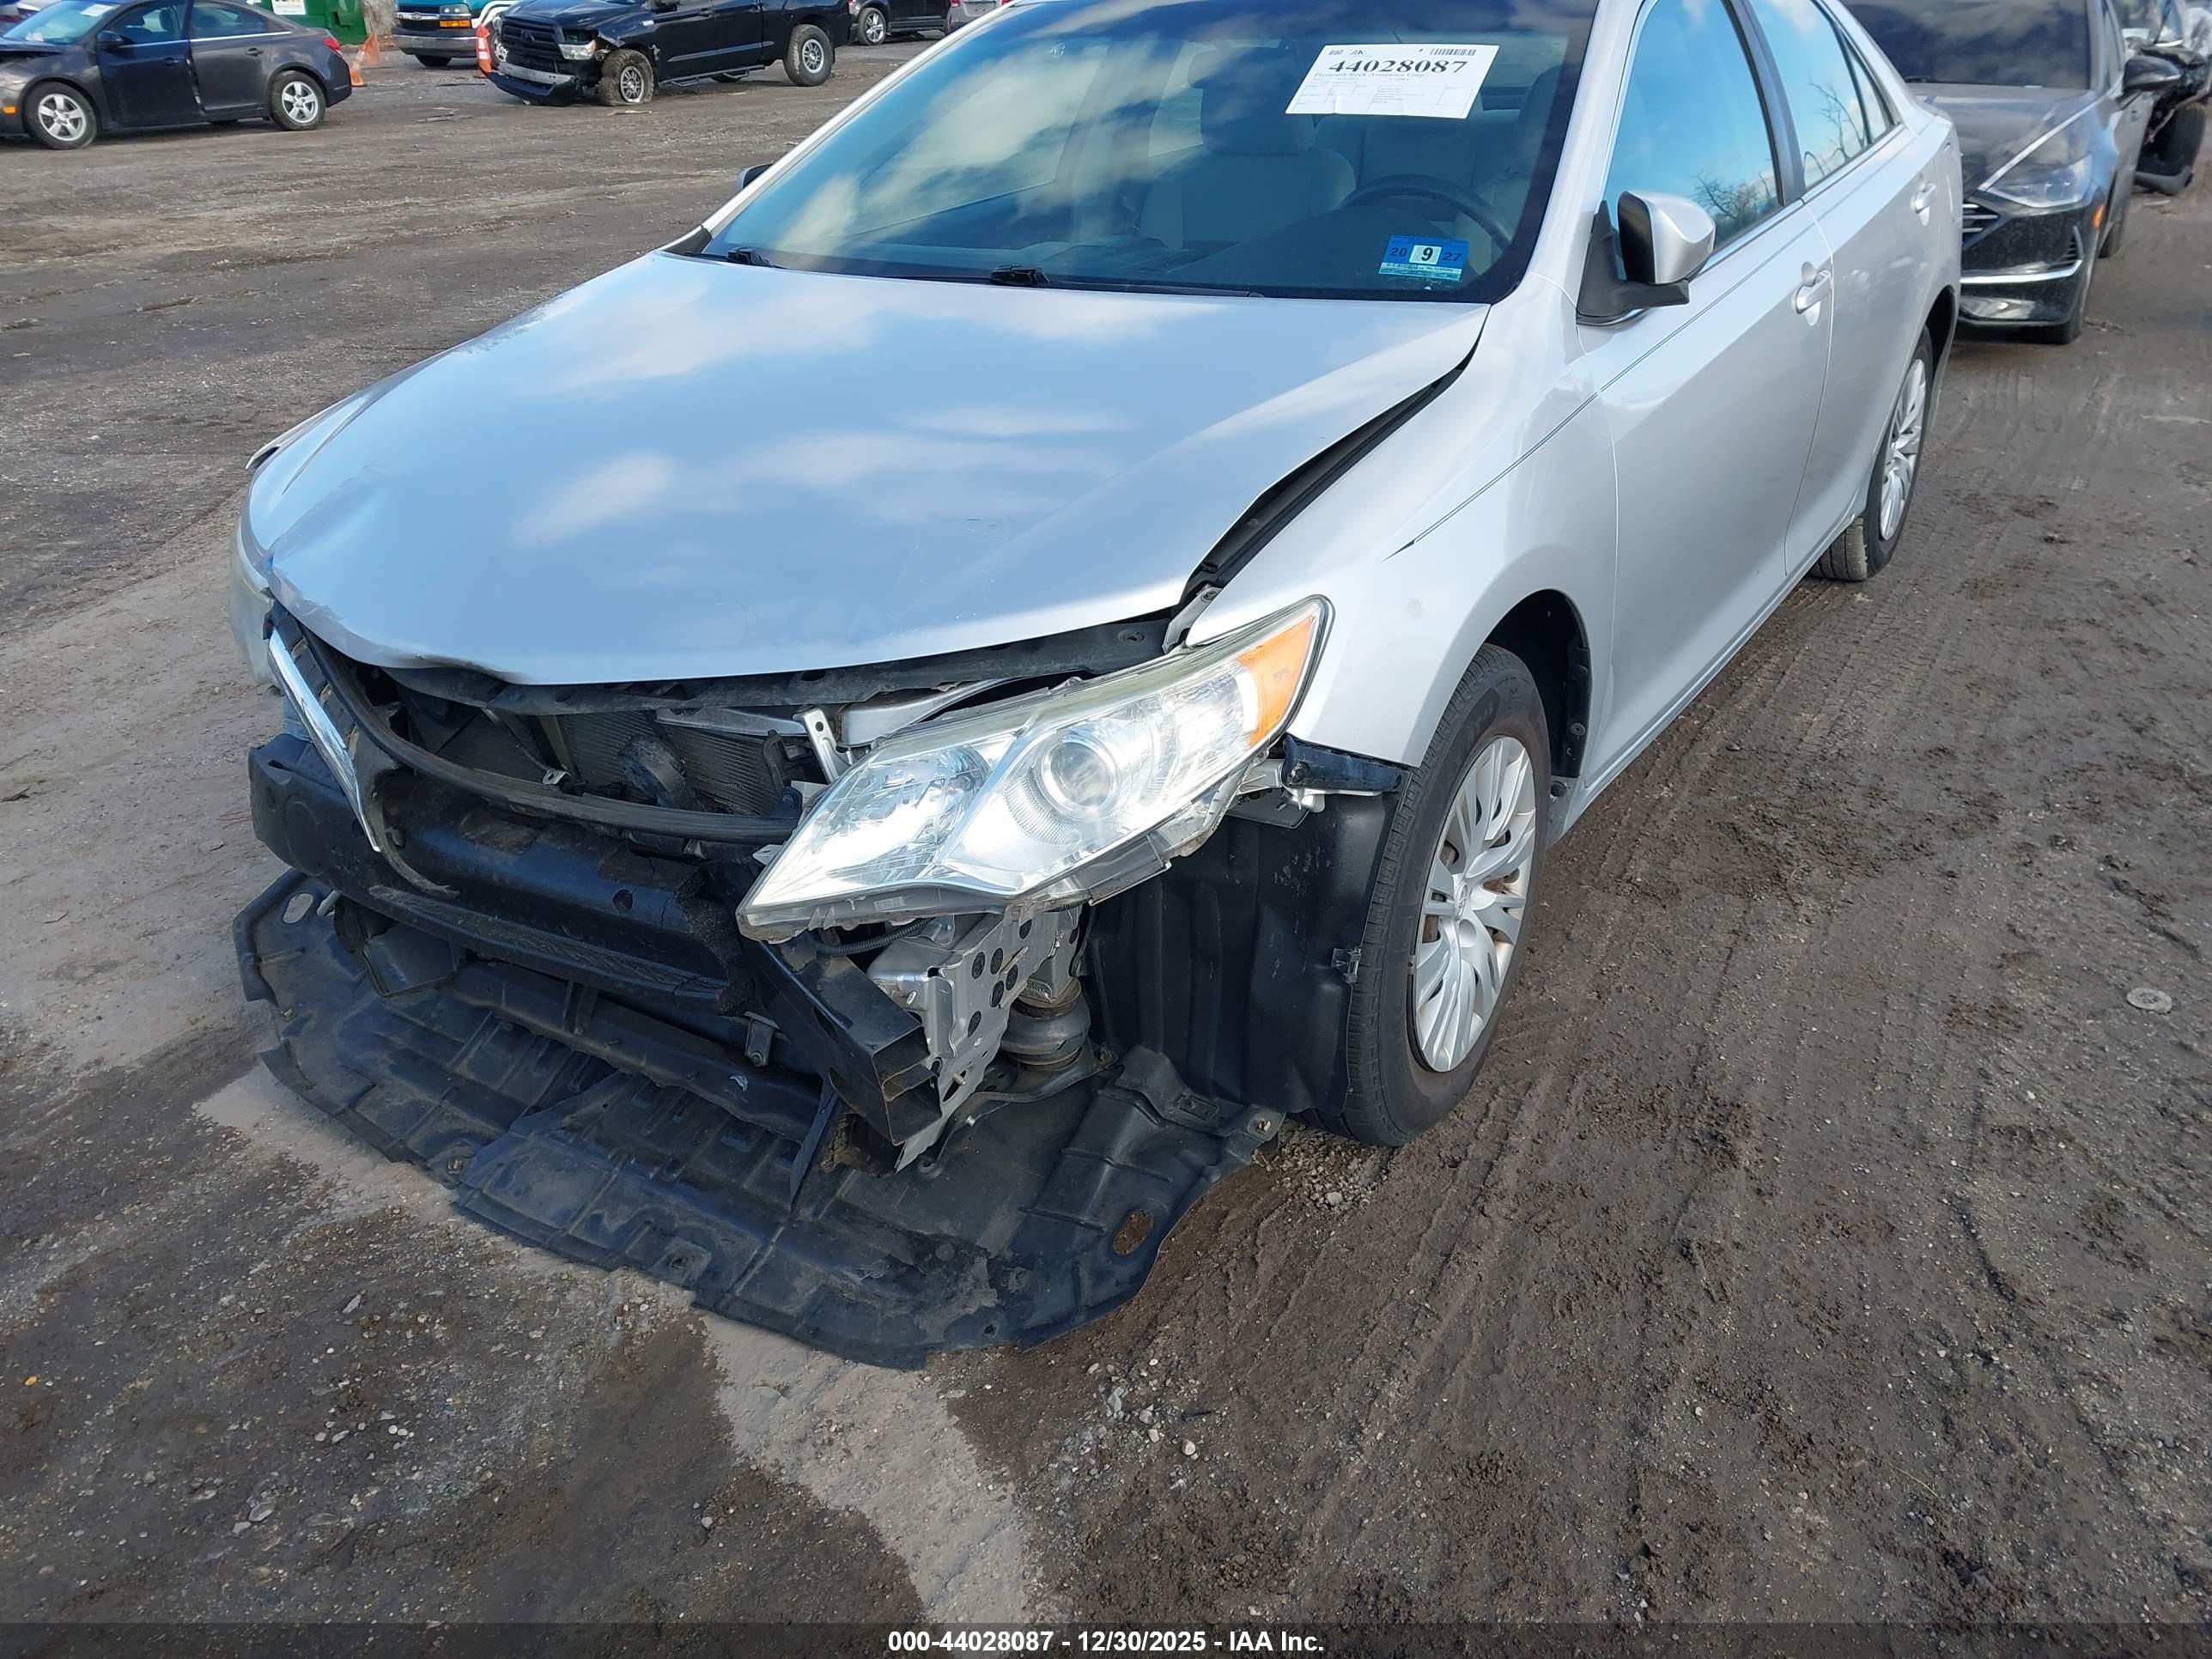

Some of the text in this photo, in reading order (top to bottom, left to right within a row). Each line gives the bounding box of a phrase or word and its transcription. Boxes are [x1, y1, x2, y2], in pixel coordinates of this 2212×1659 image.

[1328, 59, 1469, 74] 44028087
[1389, 246, 1462, 262] 20 9 27
